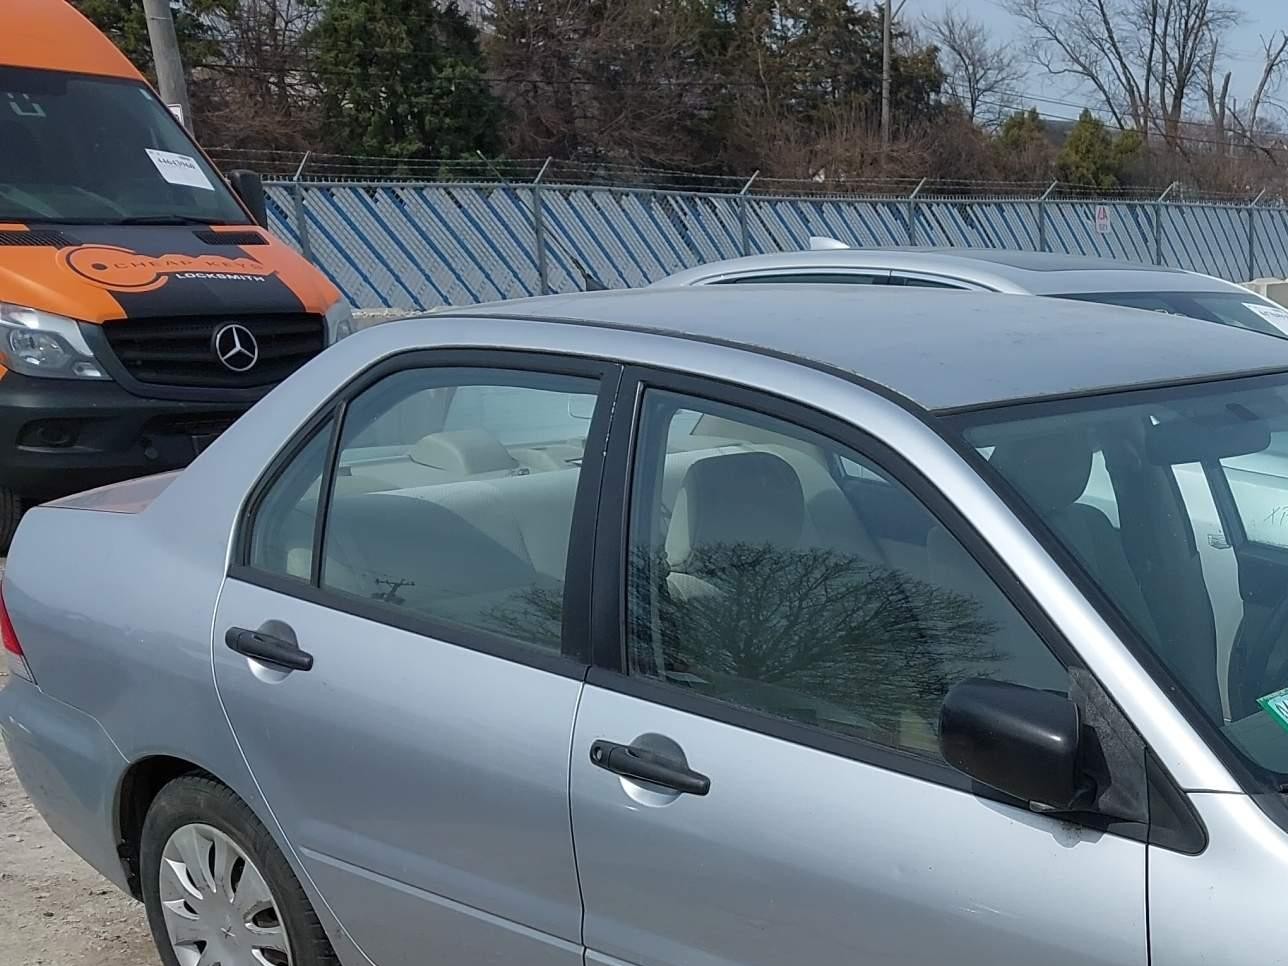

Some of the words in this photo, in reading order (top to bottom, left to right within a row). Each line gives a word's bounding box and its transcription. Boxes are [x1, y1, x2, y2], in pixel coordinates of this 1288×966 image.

[113, 260, 193, 270] CHEAP
[205, 260, 265, 270] KEYS
[176, 272, 265, 282] LOCKSMITH
